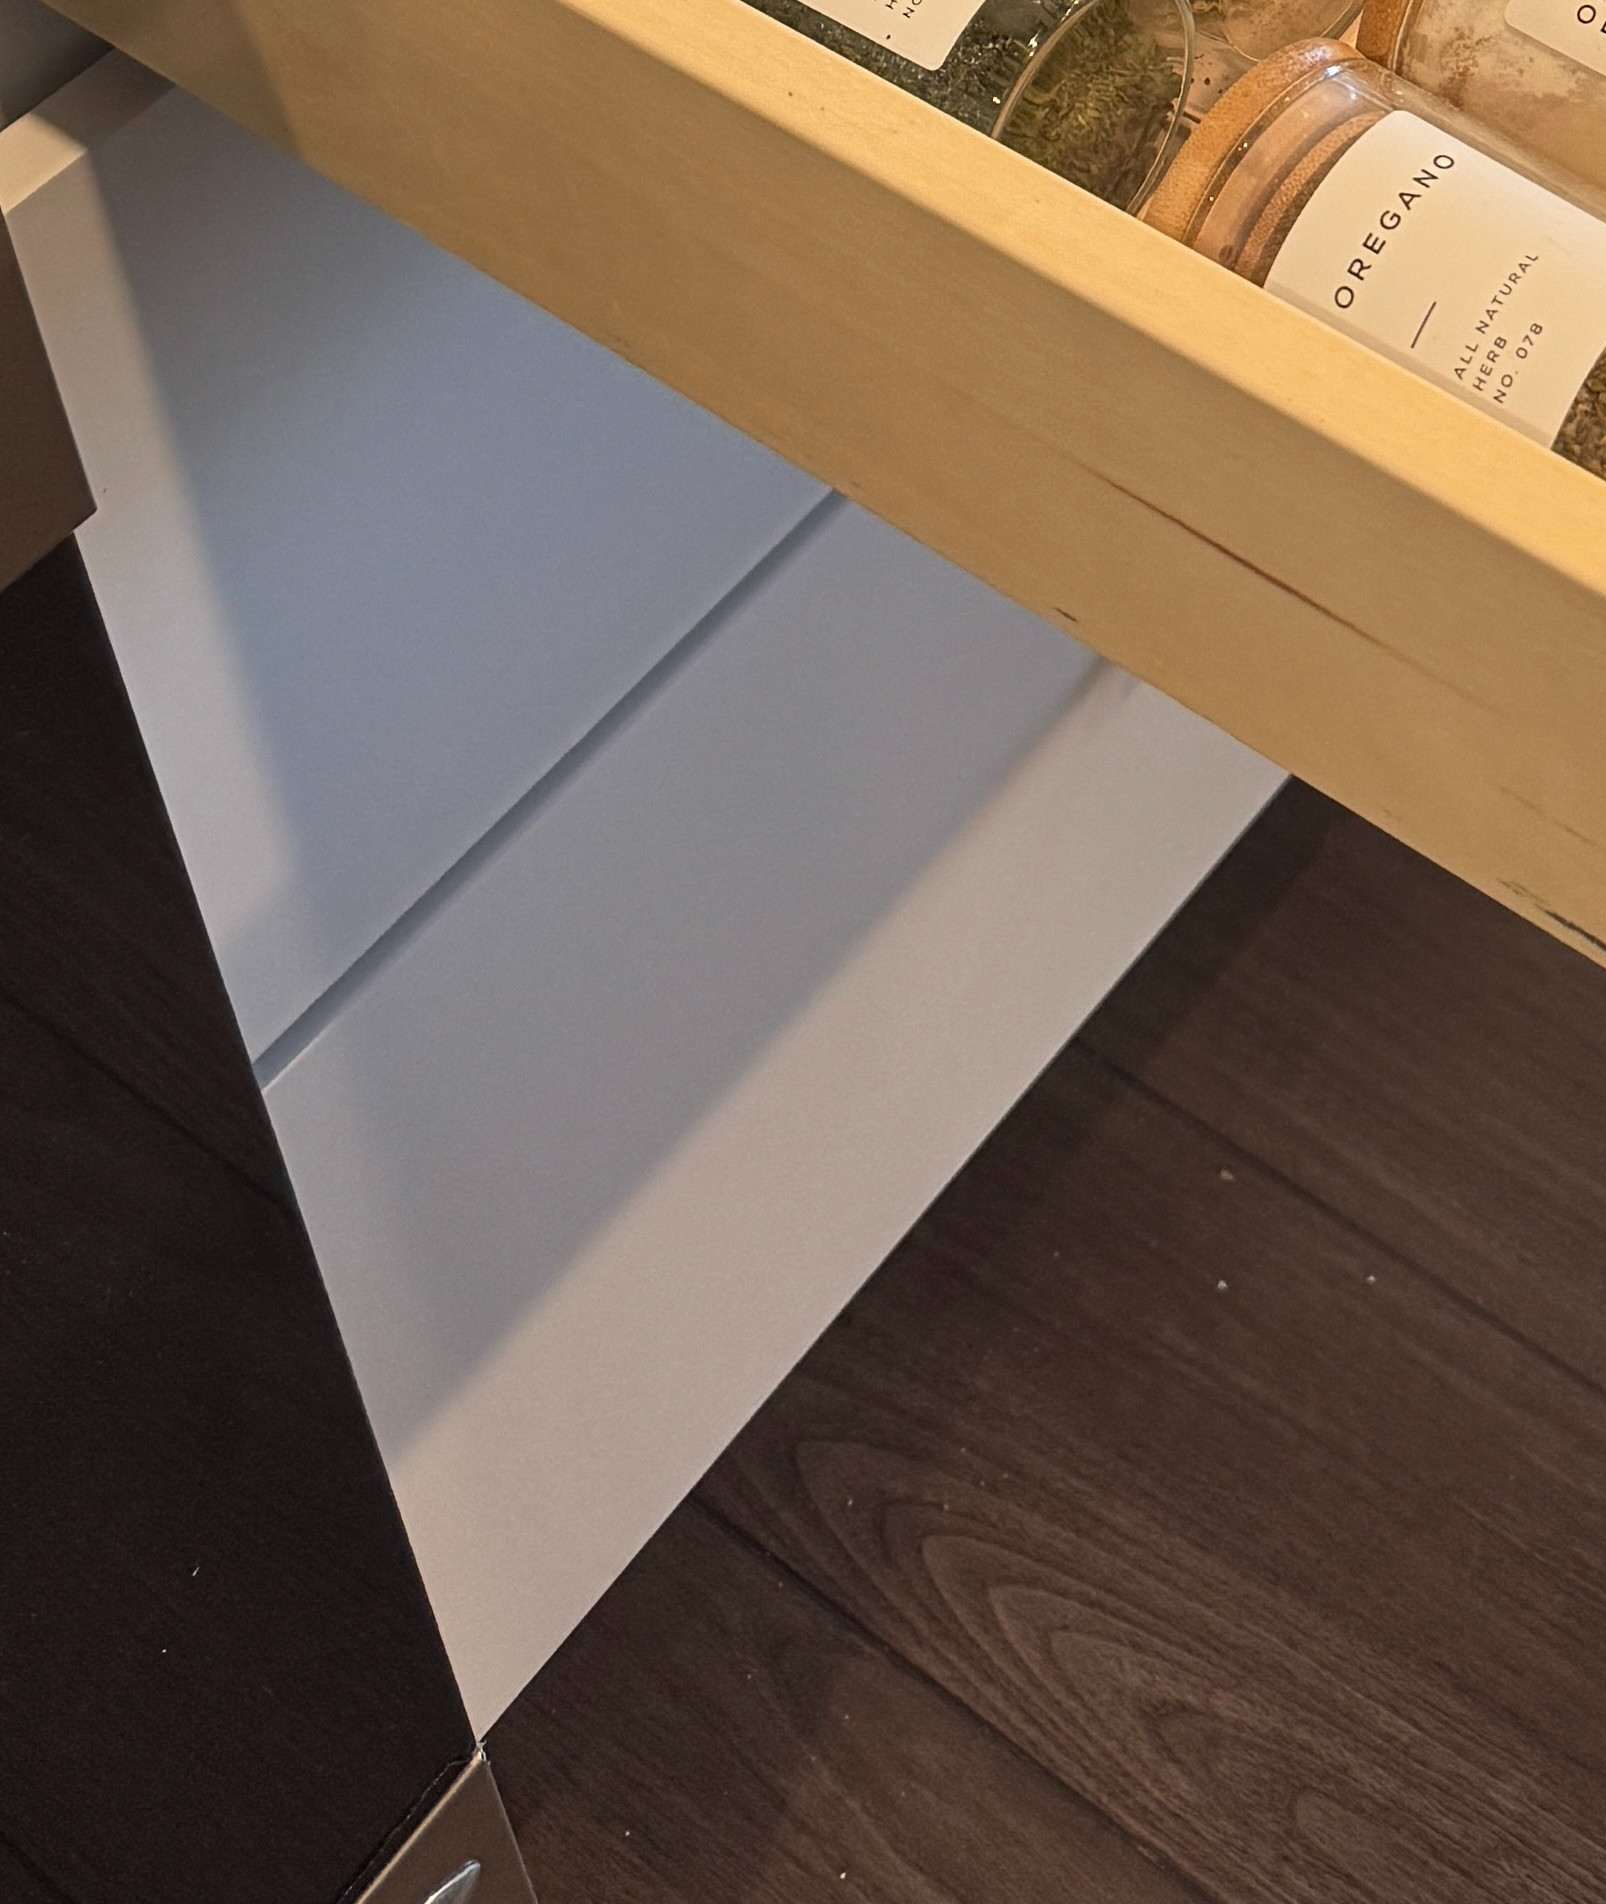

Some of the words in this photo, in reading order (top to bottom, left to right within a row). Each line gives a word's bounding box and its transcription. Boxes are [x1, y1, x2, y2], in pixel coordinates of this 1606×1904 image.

[1334, 154, 1455, 309] OREGANO
[1453, 341, 1480, 380] ALL
[1475, 253, 1540, 335] NATURAL
[1472, 335, 1508, 392] HERB
[1493, 370, 1519, 404] NO.
[1515, 322, 1544, 360] 078
